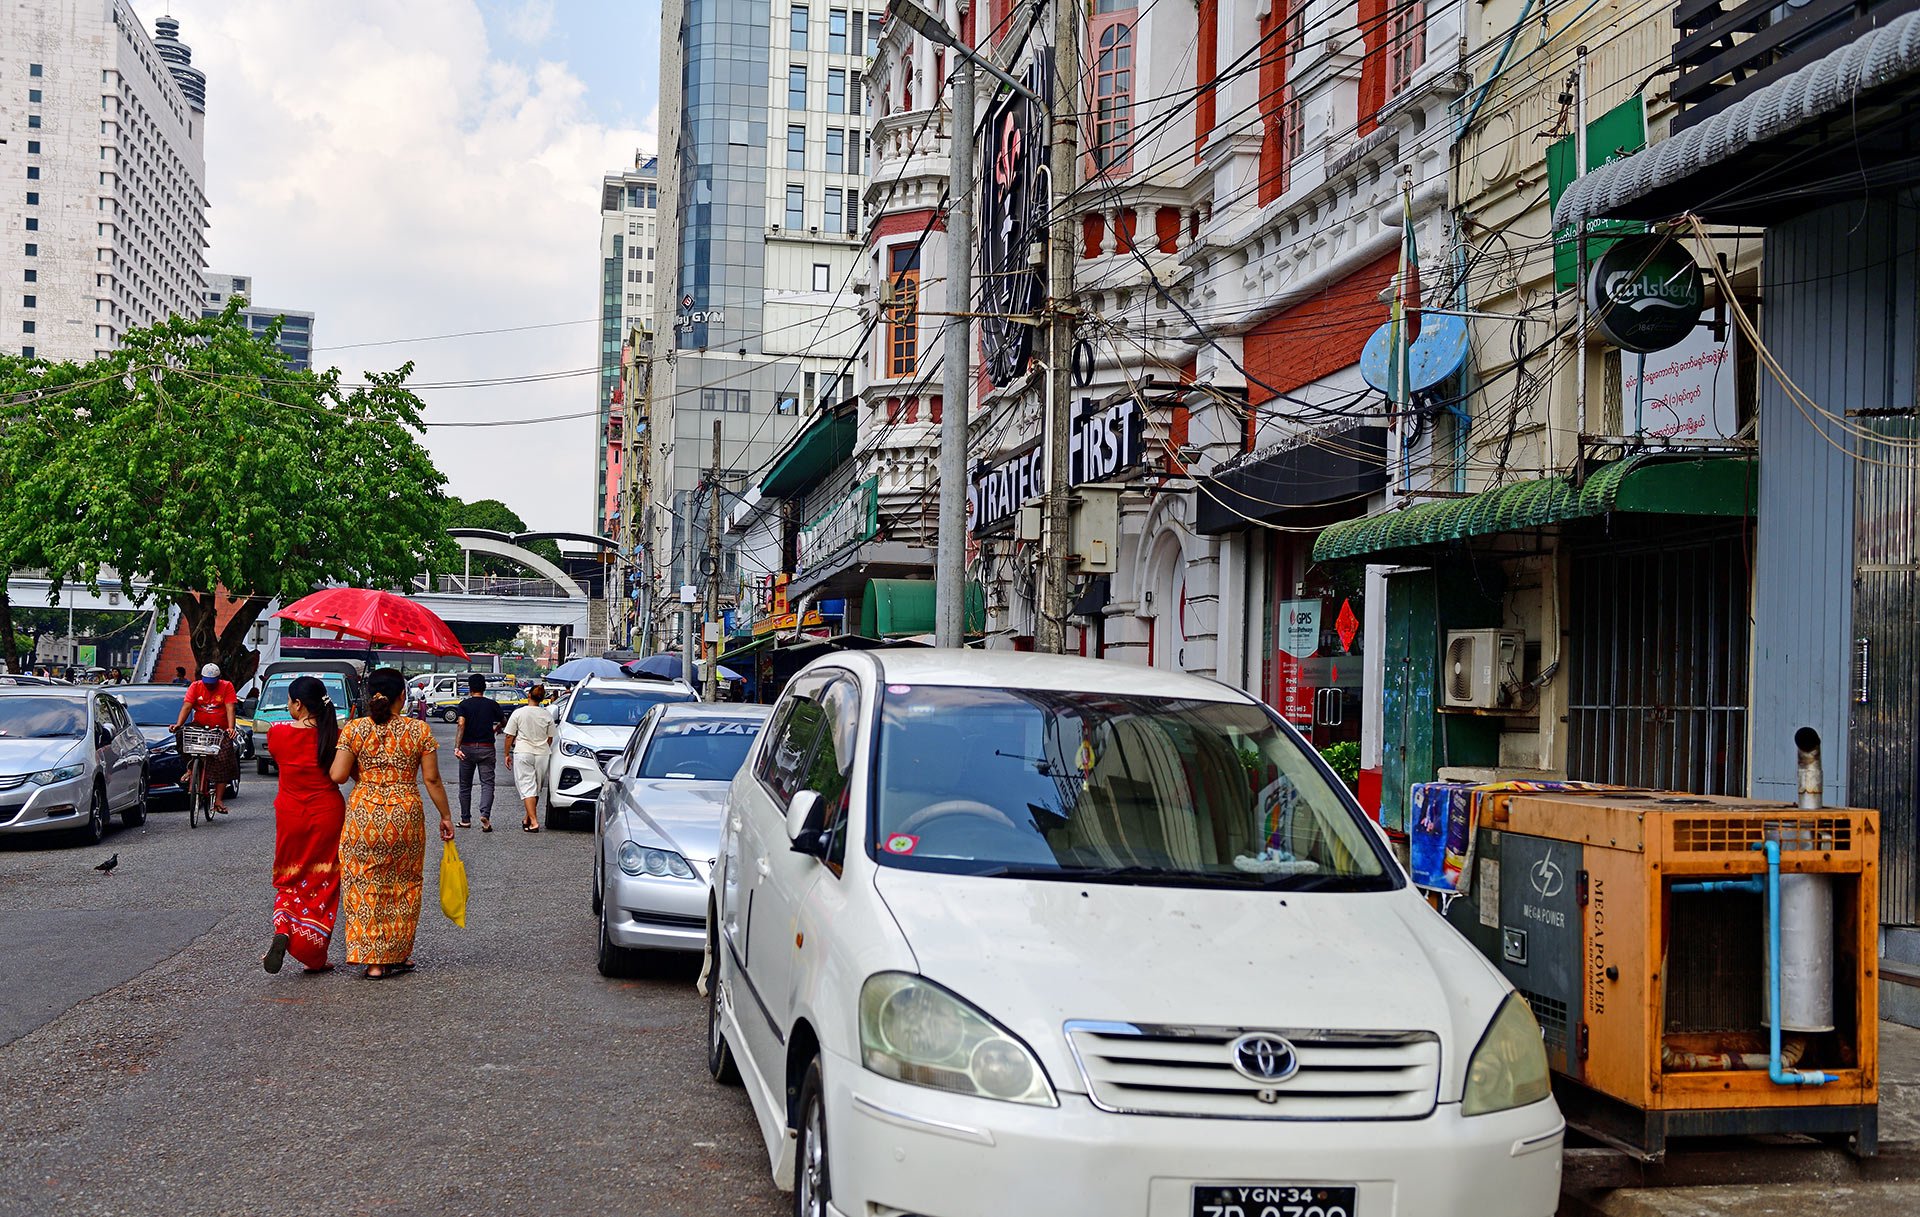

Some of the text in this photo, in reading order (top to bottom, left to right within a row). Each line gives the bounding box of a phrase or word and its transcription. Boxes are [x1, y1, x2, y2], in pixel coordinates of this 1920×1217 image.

[1605, 270, 1697, 306] Carlsberg
[692, 311, 725, 322] GYM
[1069, 399, 1134, 488] FIRST
[1296, 612, 1312, 624] GPIS
[1523, 903, 1565, 928] MEGA POWER
[1594, 879, 1605, 1015] MEGA POWER
[1238, 1188, 1313, 1203] YGN-34
